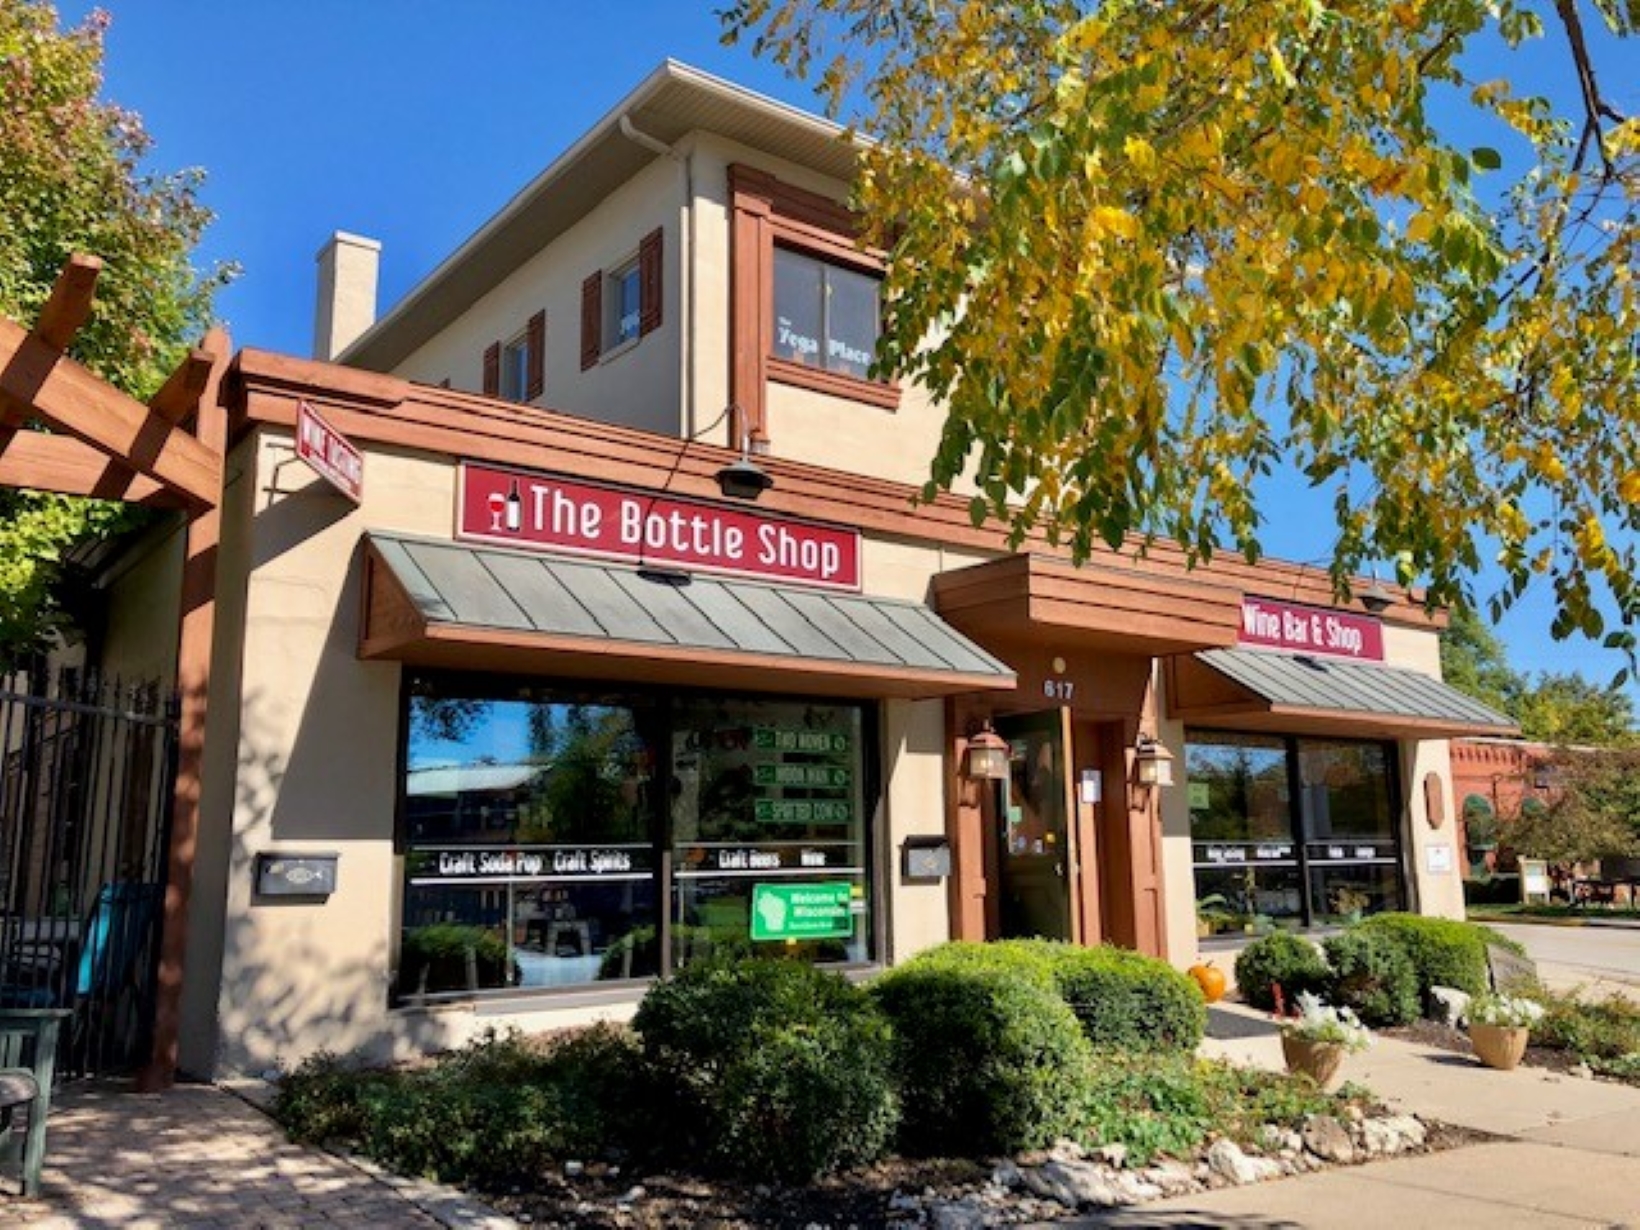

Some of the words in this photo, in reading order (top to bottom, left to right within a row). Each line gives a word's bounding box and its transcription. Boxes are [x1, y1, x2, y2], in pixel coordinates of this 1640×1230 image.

[530, 485, 601, 538] The
[621, 500, 743, 558] Bottle
[758, 524, 838, 578] Shop
[1242, 602, 1281, 639] Wine
[1283, 611, 1307, 643] Bar
[1311, 614, 1323, 646] &
[1326, 616, 1362, 655] Shop
[1044, 680, 1073, 699] 617
[439, 852, 476, 875] Craft
[479, 852, 514, 873] Soda
[516, 852, 542, 876] Pop
[554, 851, 587, 871] Craft
[590, 850, 630, 874] Spirits
[719, 849, 748, 868] Craft
